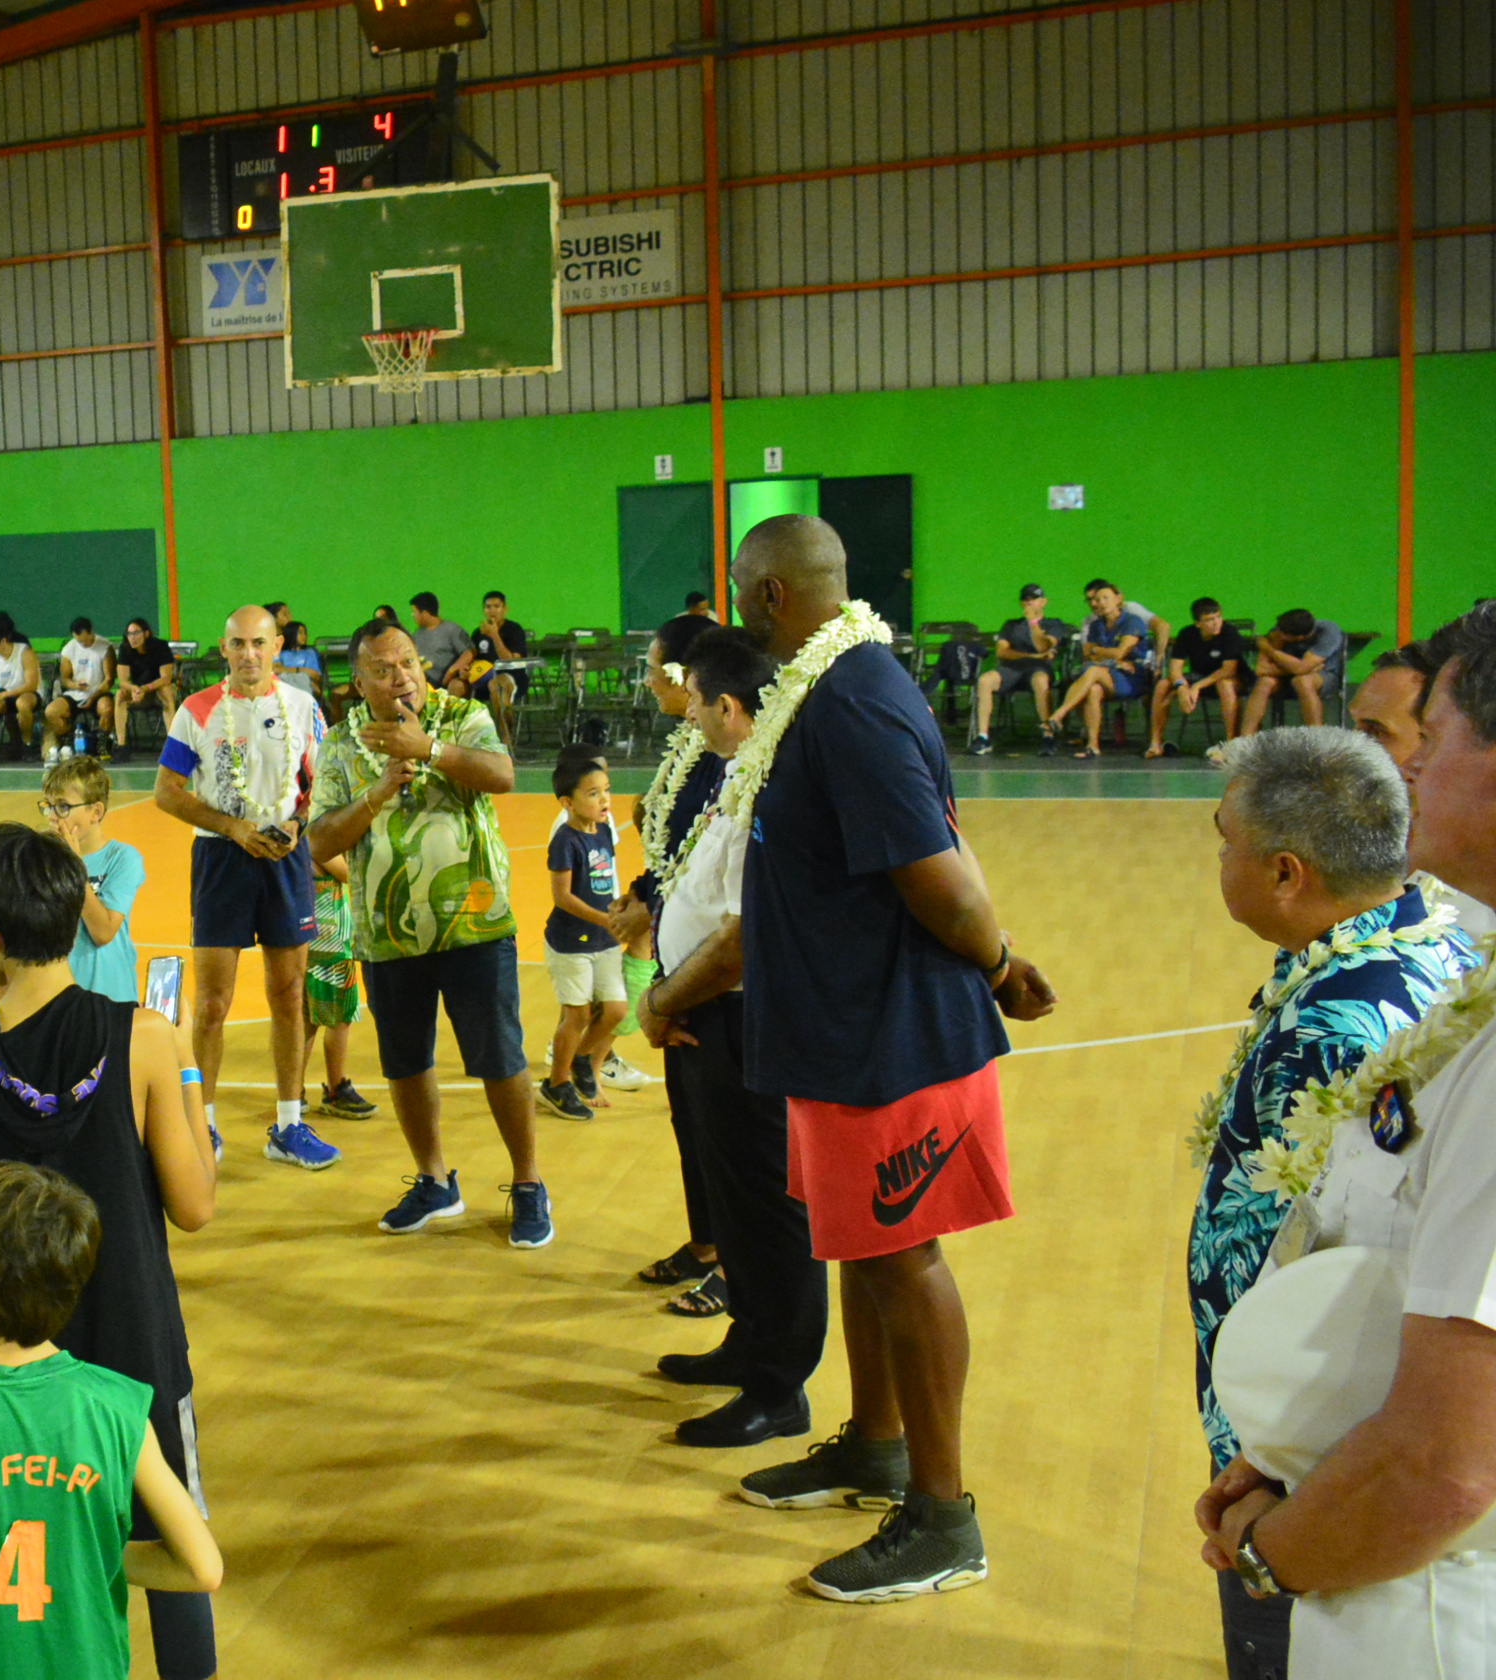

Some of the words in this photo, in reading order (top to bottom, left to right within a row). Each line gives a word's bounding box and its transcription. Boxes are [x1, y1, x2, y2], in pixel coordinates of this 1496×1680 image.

[373, 112, 393, 140] 4
[335, 143, 387, 165] VISITEU
[235, 157, 277, 178] LOCAUX
[237, 204, 253, 230] 0
[560, 230, 661, 260] SUBISHI
[564, 257, 642, 282] CTRIC
[599, 280, 672, 299] SYSTEMS
[265, 311, 277, 323] de
[874, 1125, 944, 1199] NIKE
[1, 1453, 101, 1495] FEI-PI
